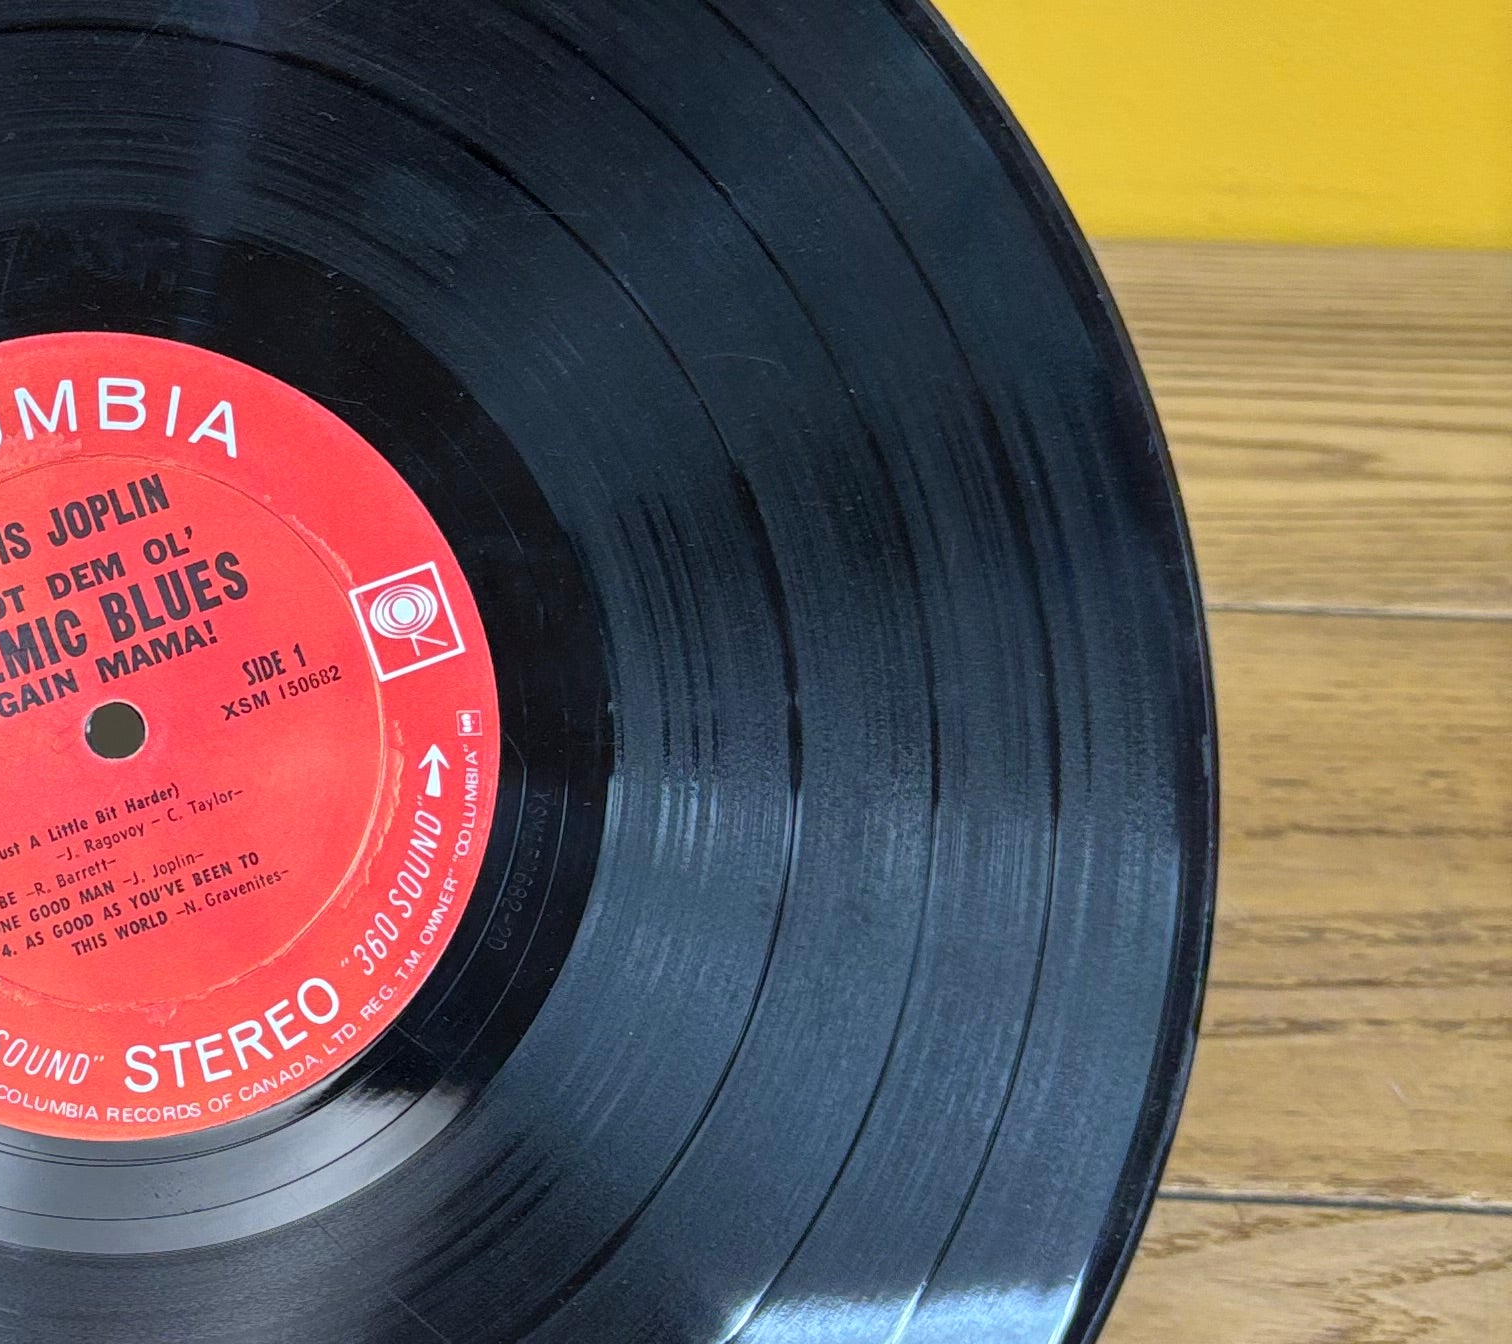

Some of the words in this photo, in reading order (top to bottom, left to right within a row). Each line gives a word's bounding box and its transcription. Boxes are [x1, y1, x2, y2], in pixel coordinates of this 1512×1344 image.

[47, 473, 170, 546] JOPLIN
[46, 552, 126, 600] DEM
[143, 526, 193, 564] OL'
[99, 551, 249, 643] BLUES
[95, 620, 218, 683] MAMA!
[242, 650, 286, 686] SIDE
[293, 643, 307, 668] 1
[220, 689, 271, 721] XSM
[278, 665, 343, 700] 150682
[30, 835, 41, 849] A
[47, 817, 88, 842] Little
[95, 806, 117, 824] Bit
[125, 782, 180, 813] Harder)
[84, 822, 144, 853] Ragovoy
[167, 808, 183, 822] C.
[1, 944, 17, 957] 4.
[25, 931, 45, 950] AS
[52, 913, 94, 939] GOOD
[103, 902, 123, 921] AS
[129, 879, 185, 910] YOU'VE
[192, 861, 233, 887] BEEN
[238, 851, 259, 869] TO
[29, 897, 71, 922] GOOD
[79, 880, 115, 904] MAN
[71, 932, 107, 956] THIS
[114, 910, 168, 940] WORLD
[107, 1102, 201, 1123] RECORDS
[207, 1093, 232, 1113] OF
[322, 1022, 363, 1055] LTD.
[360, 983, 398, 1021] REG.
[395, 950, 425, 980] T.M.
[124, 977, 340, 1093] STEREO
